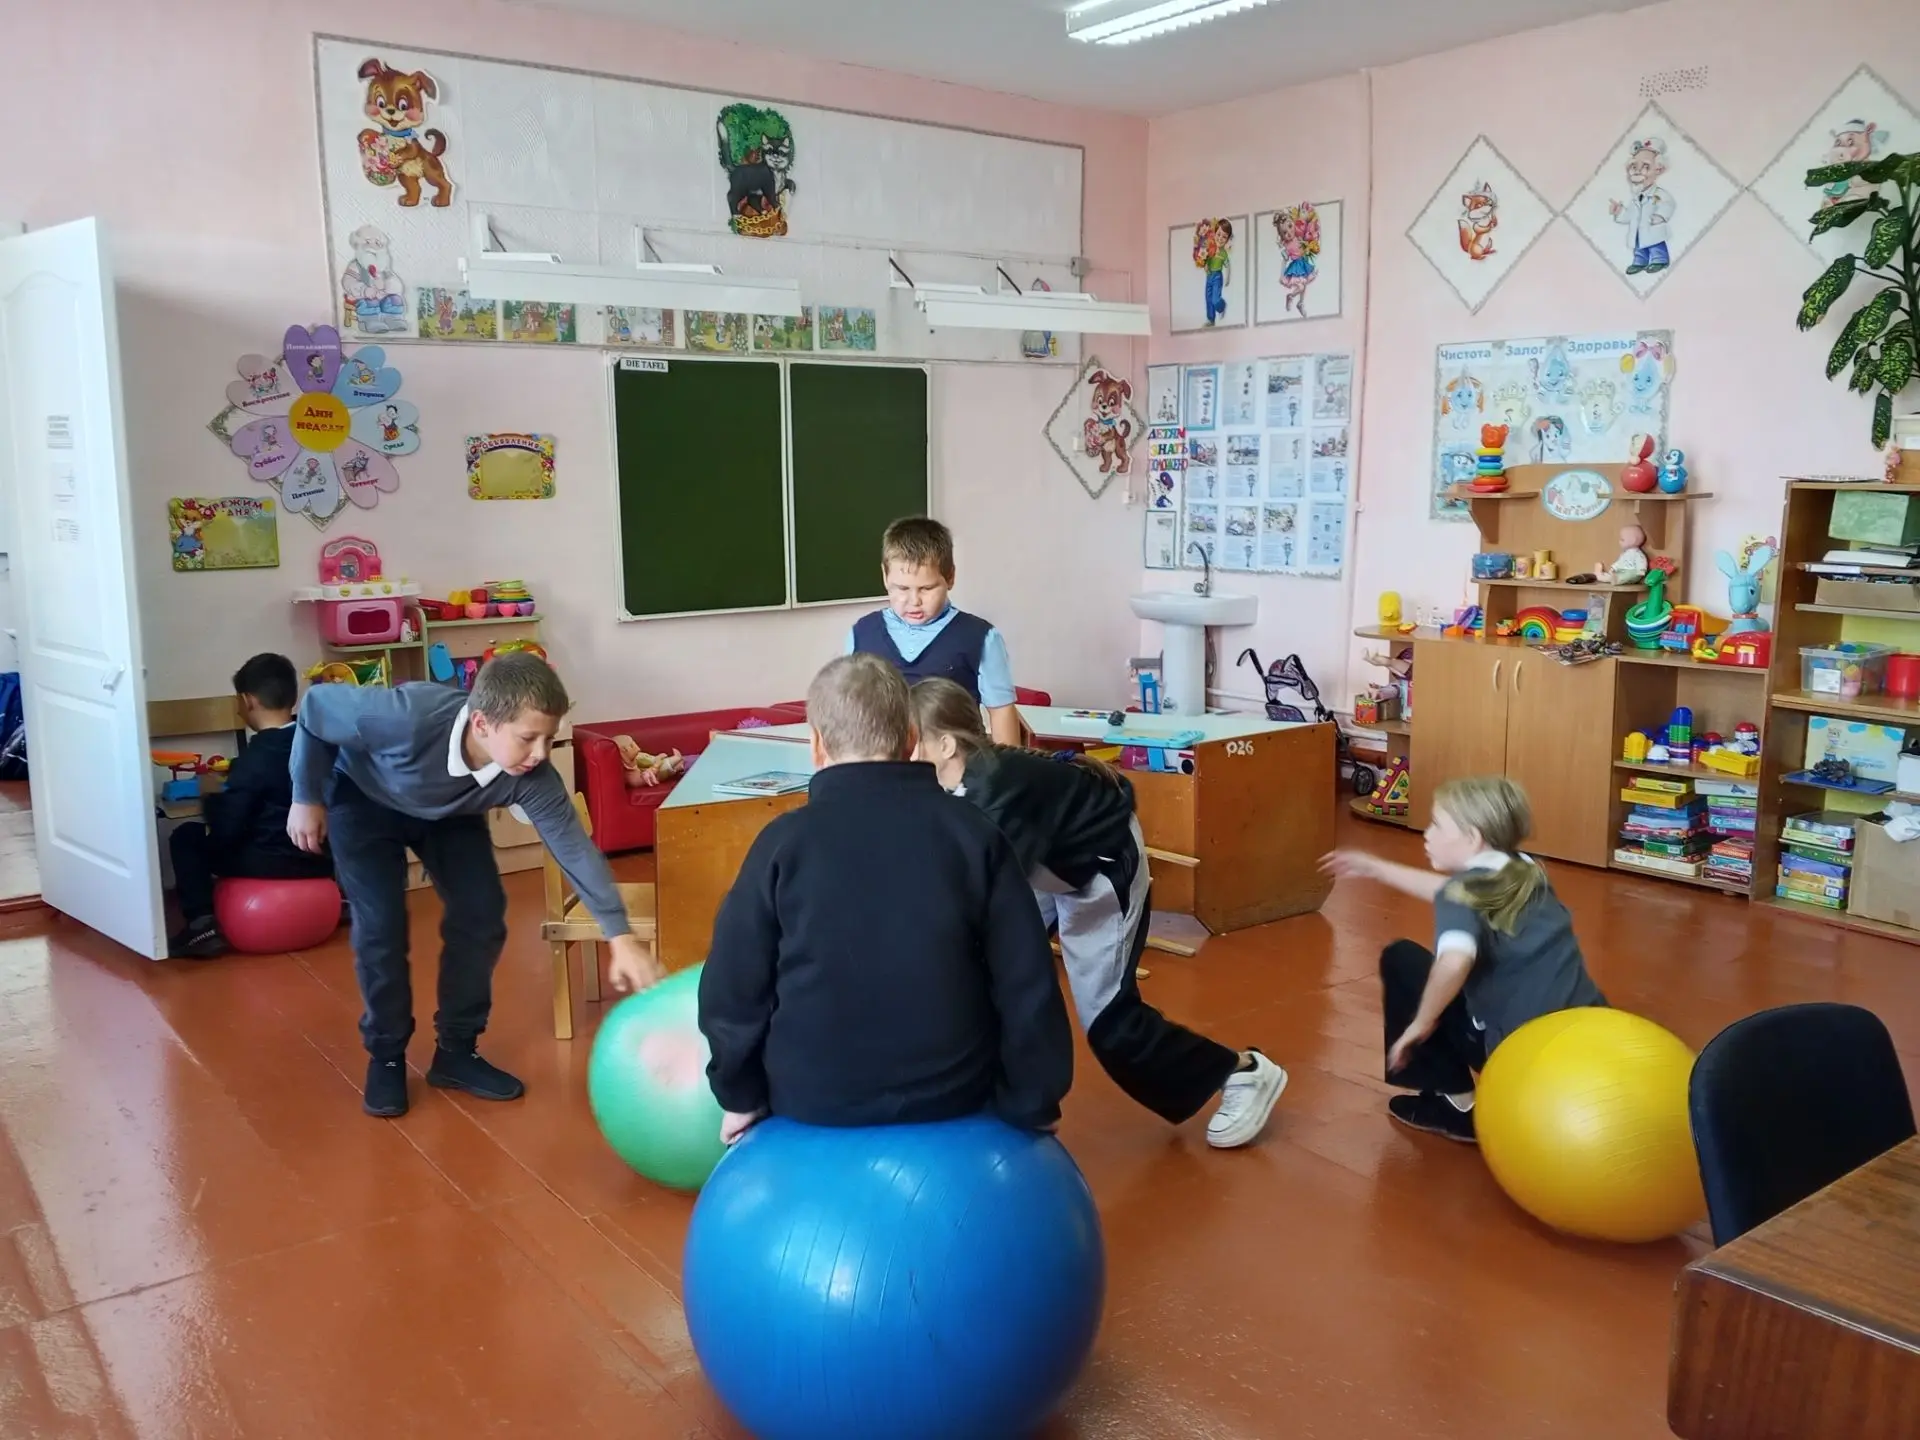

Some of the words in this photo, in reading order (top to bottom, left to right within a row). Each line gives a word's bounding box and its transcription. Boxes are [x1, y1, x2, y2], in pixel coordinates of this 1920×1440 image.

[1440, 349, 1492, 360] Чистота
[1505, 345, 1544, 356] Залог
[641, 361, 666, 370] TAFEL
[304, 406, 334, 419] Дни
[296, 421, 345, 432] недели
[1148, 427, 1186, 440] ДЕТЯМ
[1151, 443, 1188, 457] ЗНАТЬ
[254, 455, 286, 469] Суббота
[291, 488, 325, 499] Пятница
[227, 508, 250, 517] ДНЯ
